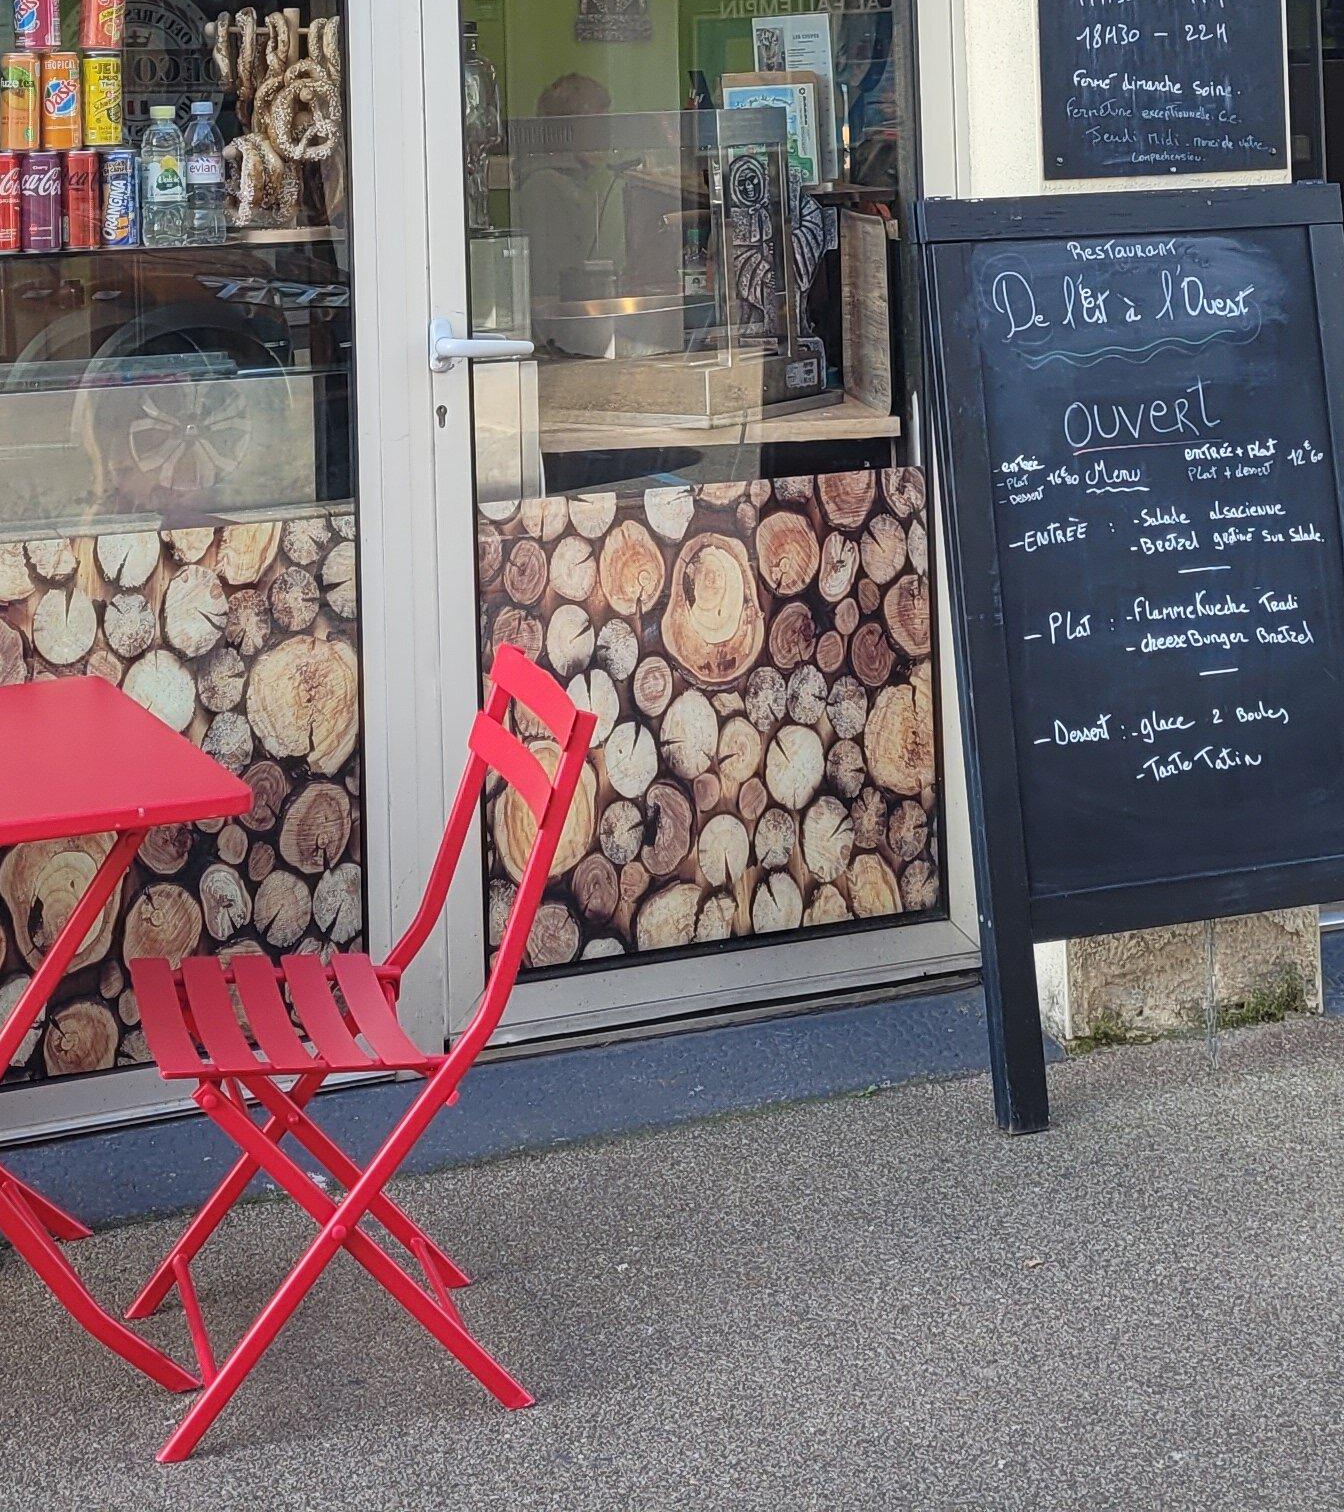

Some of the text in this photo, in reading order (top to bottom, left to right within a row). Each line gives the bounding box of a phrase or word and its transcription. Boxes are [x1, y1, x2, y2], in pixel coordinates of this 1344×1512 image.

[1076, 26, 1228, 52] 18H30 22H
[1122, 73, 1183, 94] dimanche
[44, 80, 79, 115] Oasis
[189, 164, 217, 173] evian
[102, 180, 128, 240] ORANGINA
[993, 271, 1050, 339] De
[1118, 293, 1141, 322] à
[1085, 459, 1141, 485] Menu
[1211, 707, 1222, 725] 2
